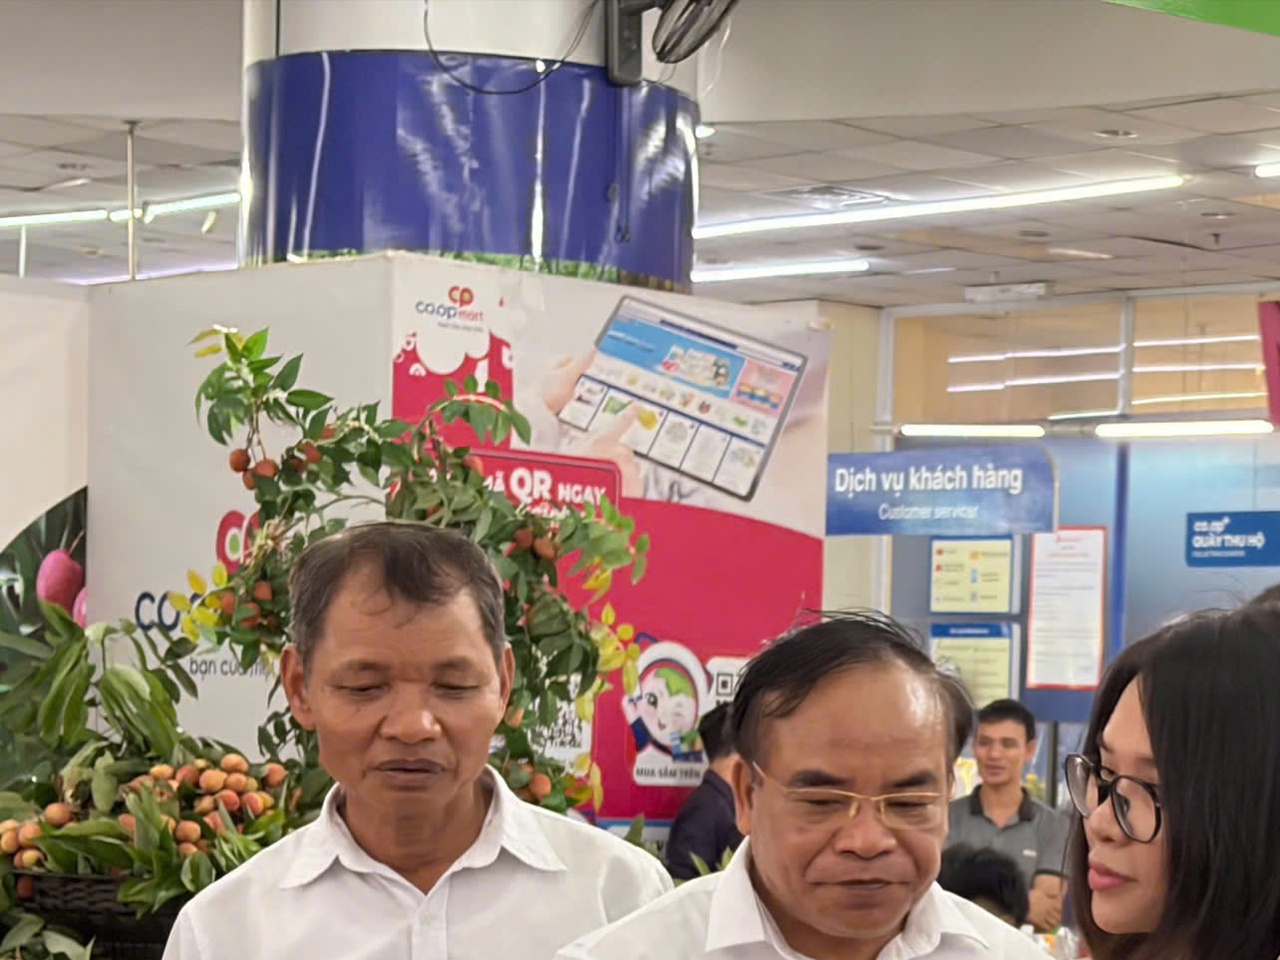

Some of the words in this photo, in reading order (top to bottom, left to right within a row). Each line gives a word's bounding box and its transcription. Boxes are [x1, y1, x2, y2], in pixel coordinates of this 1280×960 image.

[509, 467, 553, 504] QR
[557, 483, 607, 506] NGAY
[834, 467, 877, 498] Dịch
[881, 472, 905, 497] vụ
[908, 464, 968, 492] khách
[972, 462, 1024, 494] hàng
[878, 503, 932, 520] Customer
